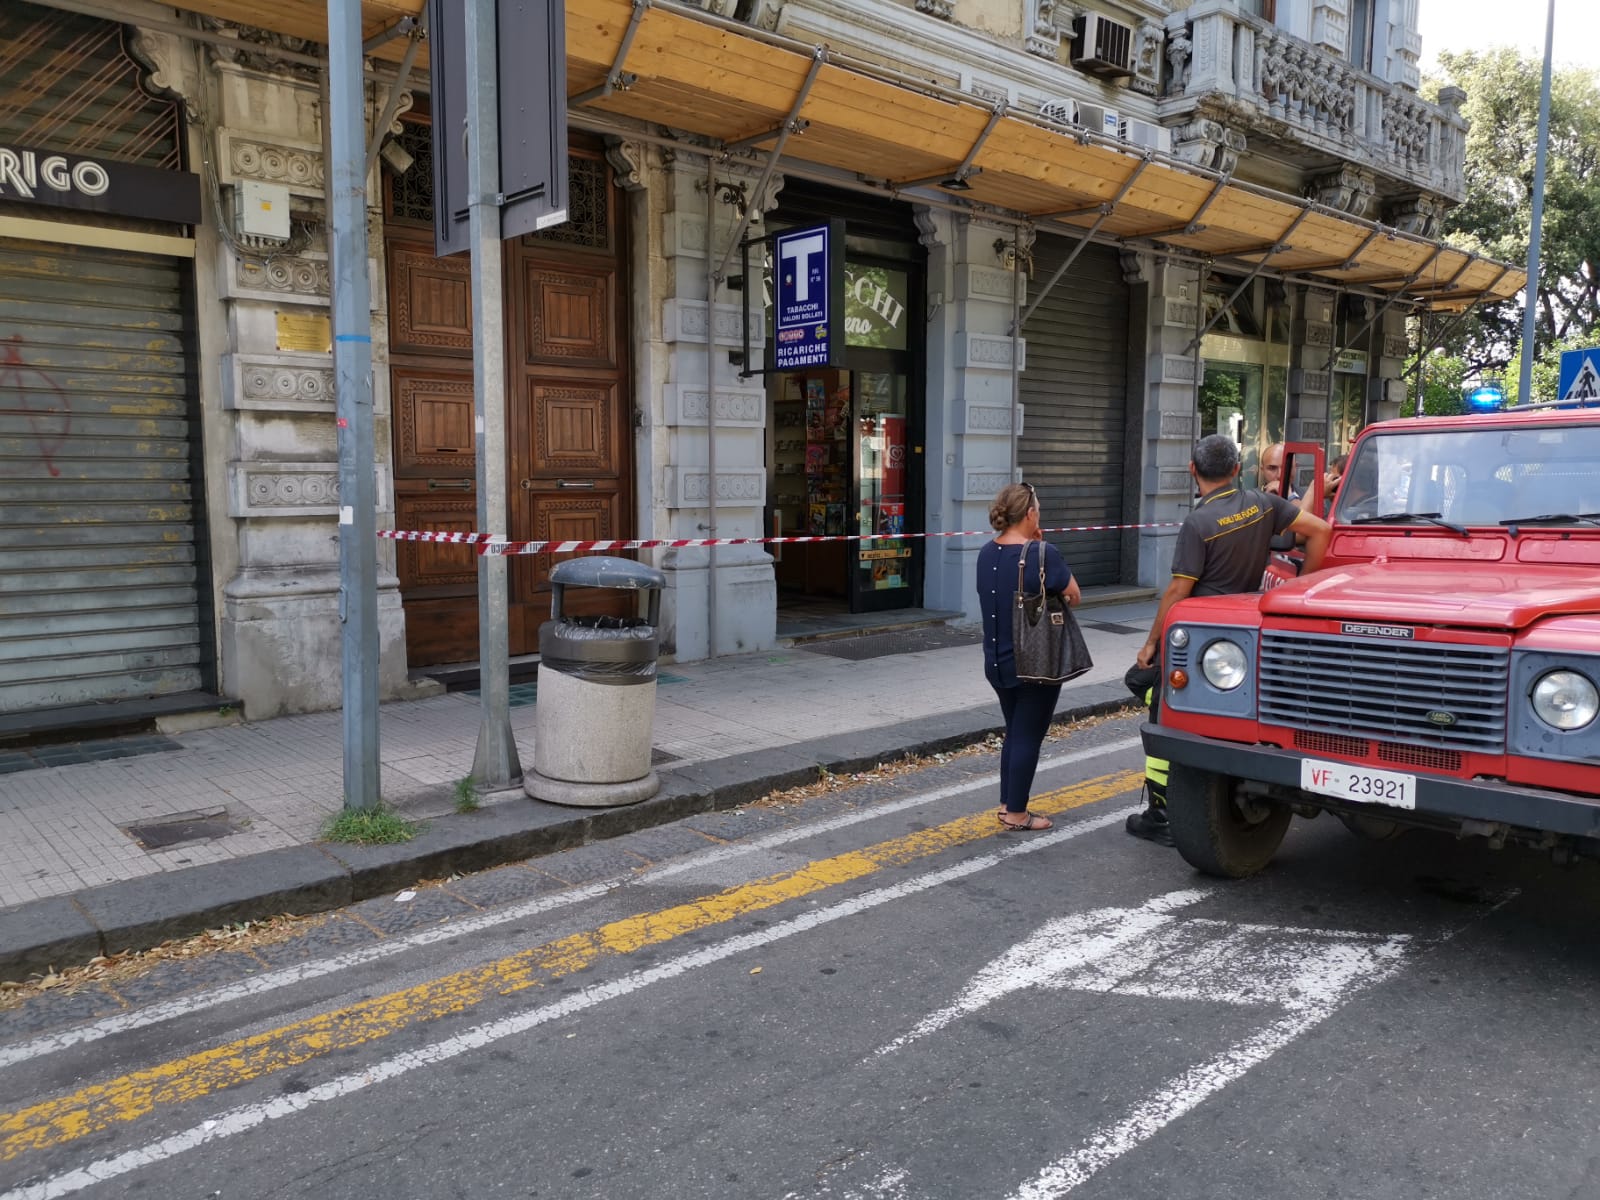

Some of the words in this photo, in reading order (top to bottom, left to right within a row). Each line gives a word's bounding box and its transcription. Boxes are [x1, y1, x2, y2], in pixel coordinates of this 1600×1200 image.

[0, 148, 110, 199] RIGO
[782, 235, 823, 302] T
[787, 303, 818, 313] TABACCHI
[778, 343, 826, 356] RICARICHE
[778, 353, 826, 367] PAGAMENTI
[1345, 624, 1409, 637] DEFENDER
[1311, 768, 1333, 787] VF
[1348, 774, 1405, 801] 23921
